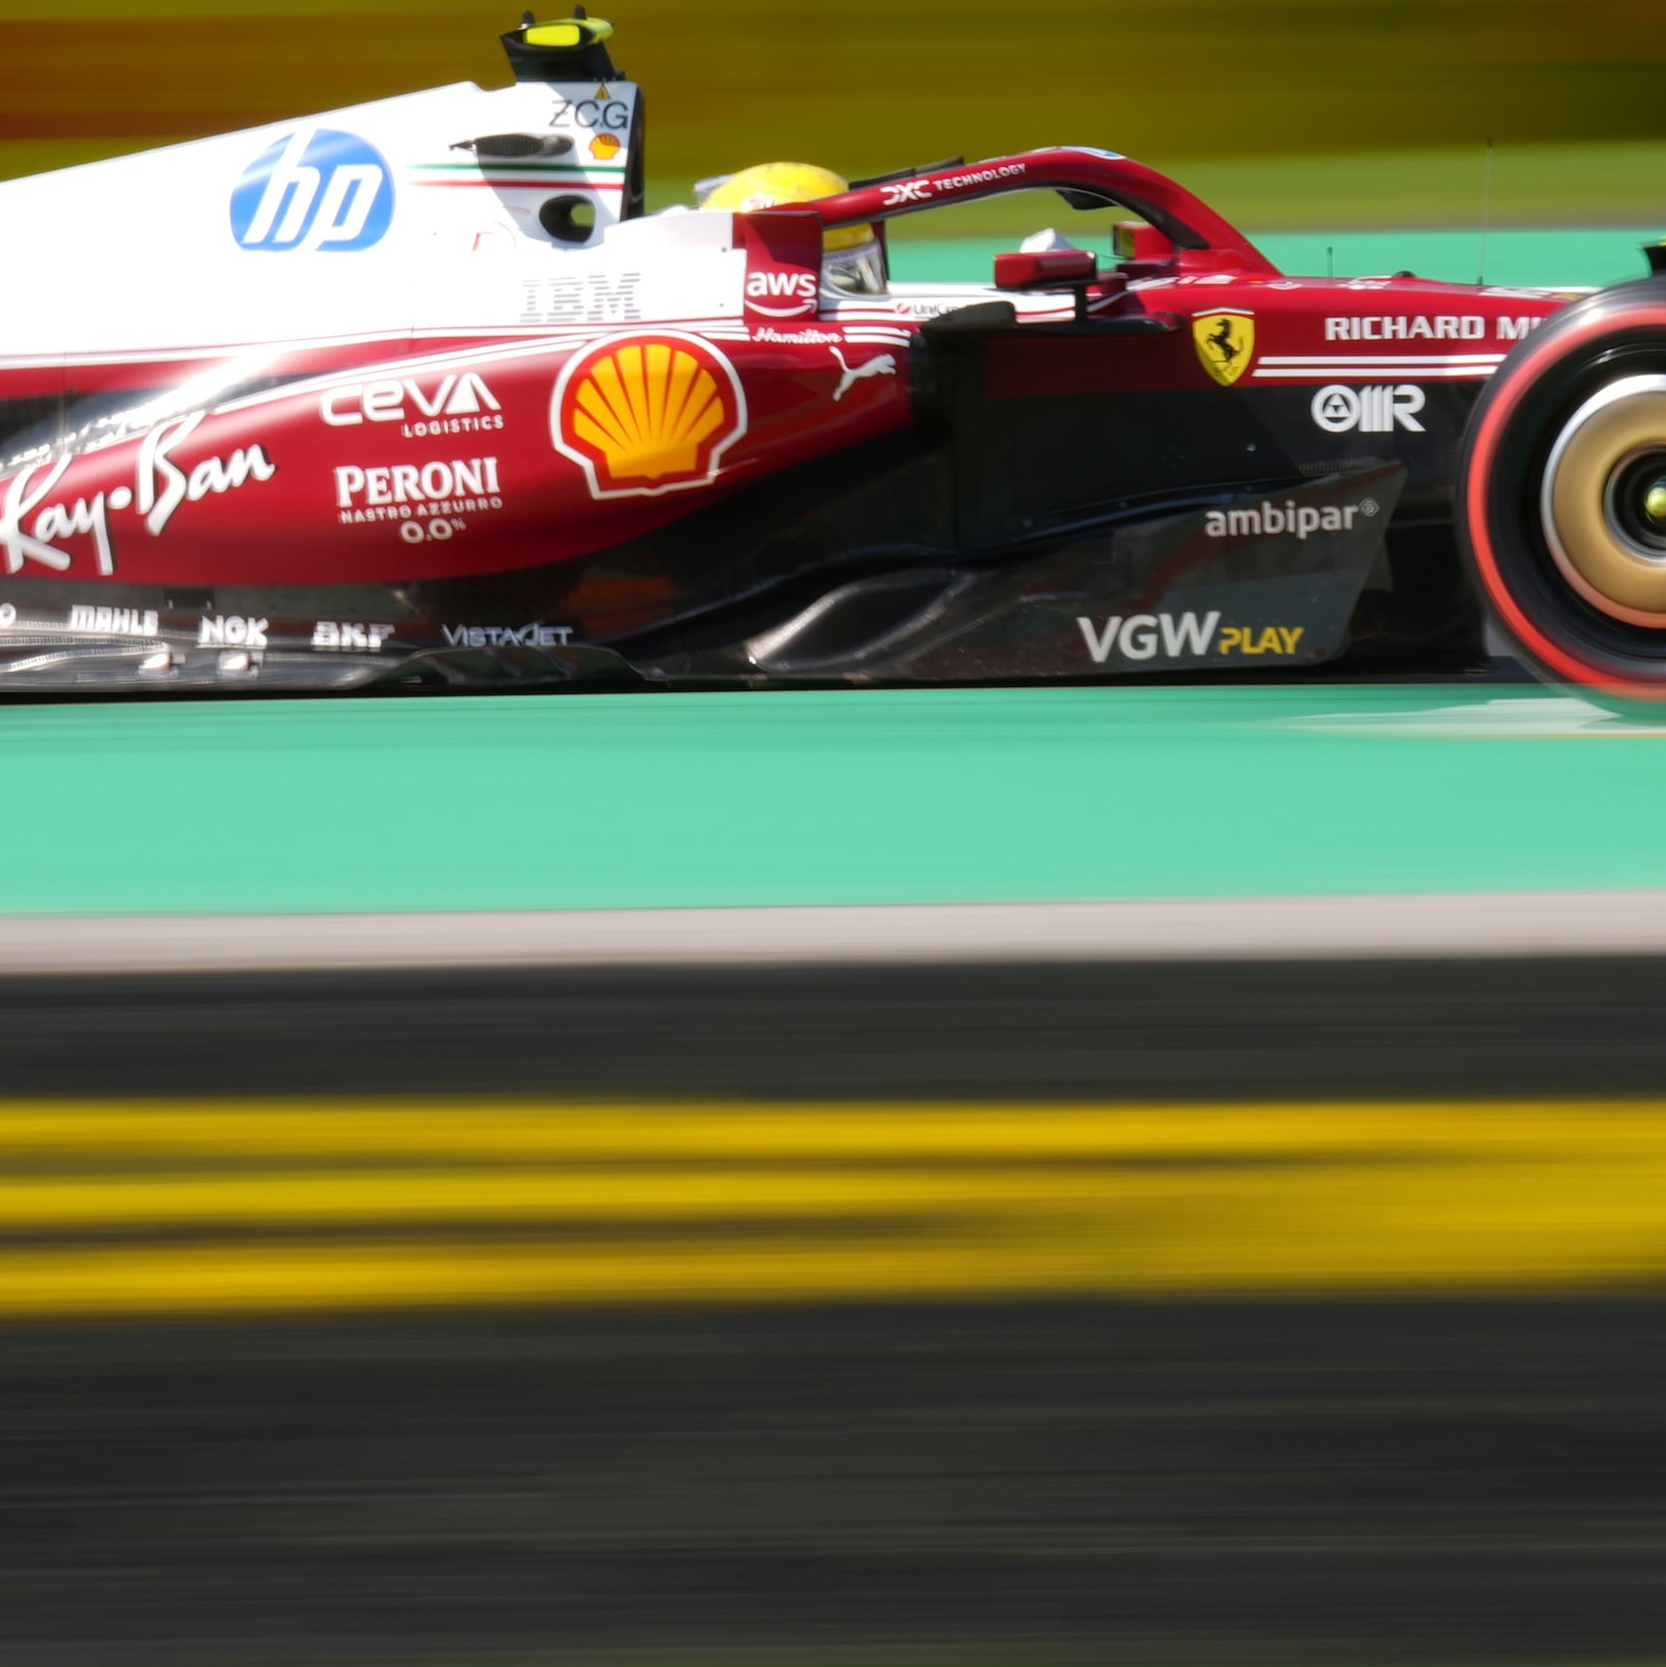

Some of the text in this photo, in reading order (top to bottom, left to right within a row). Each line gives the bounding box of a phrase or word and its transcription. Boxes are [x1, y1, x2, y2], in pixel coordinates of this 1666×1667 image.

[549, 100, 629, 129] ZCG
[239, 128, 385, 251] hp
[879, 163, 1026, 206] DXC TECHNOLOGY
[520, 273, 641, 323] IBM
[747, 271, 817, 297] aws
[752, 327, 843, 344] Hamilton
[1324, 316, 1486, 340] RICHARD
[402, 415, 504, 438] LOGISTICS
[335, 456, 501, 508] PERONI
[339, 496, 503, 524] NASTRO AZZURRO
[1205, 500, 1359, 539] ambipar
[70, 604, 159, 636] MAHLE
[198, 615, 269, 647] NGK
[1077, 611, 1305, 663] VGW PLAY
